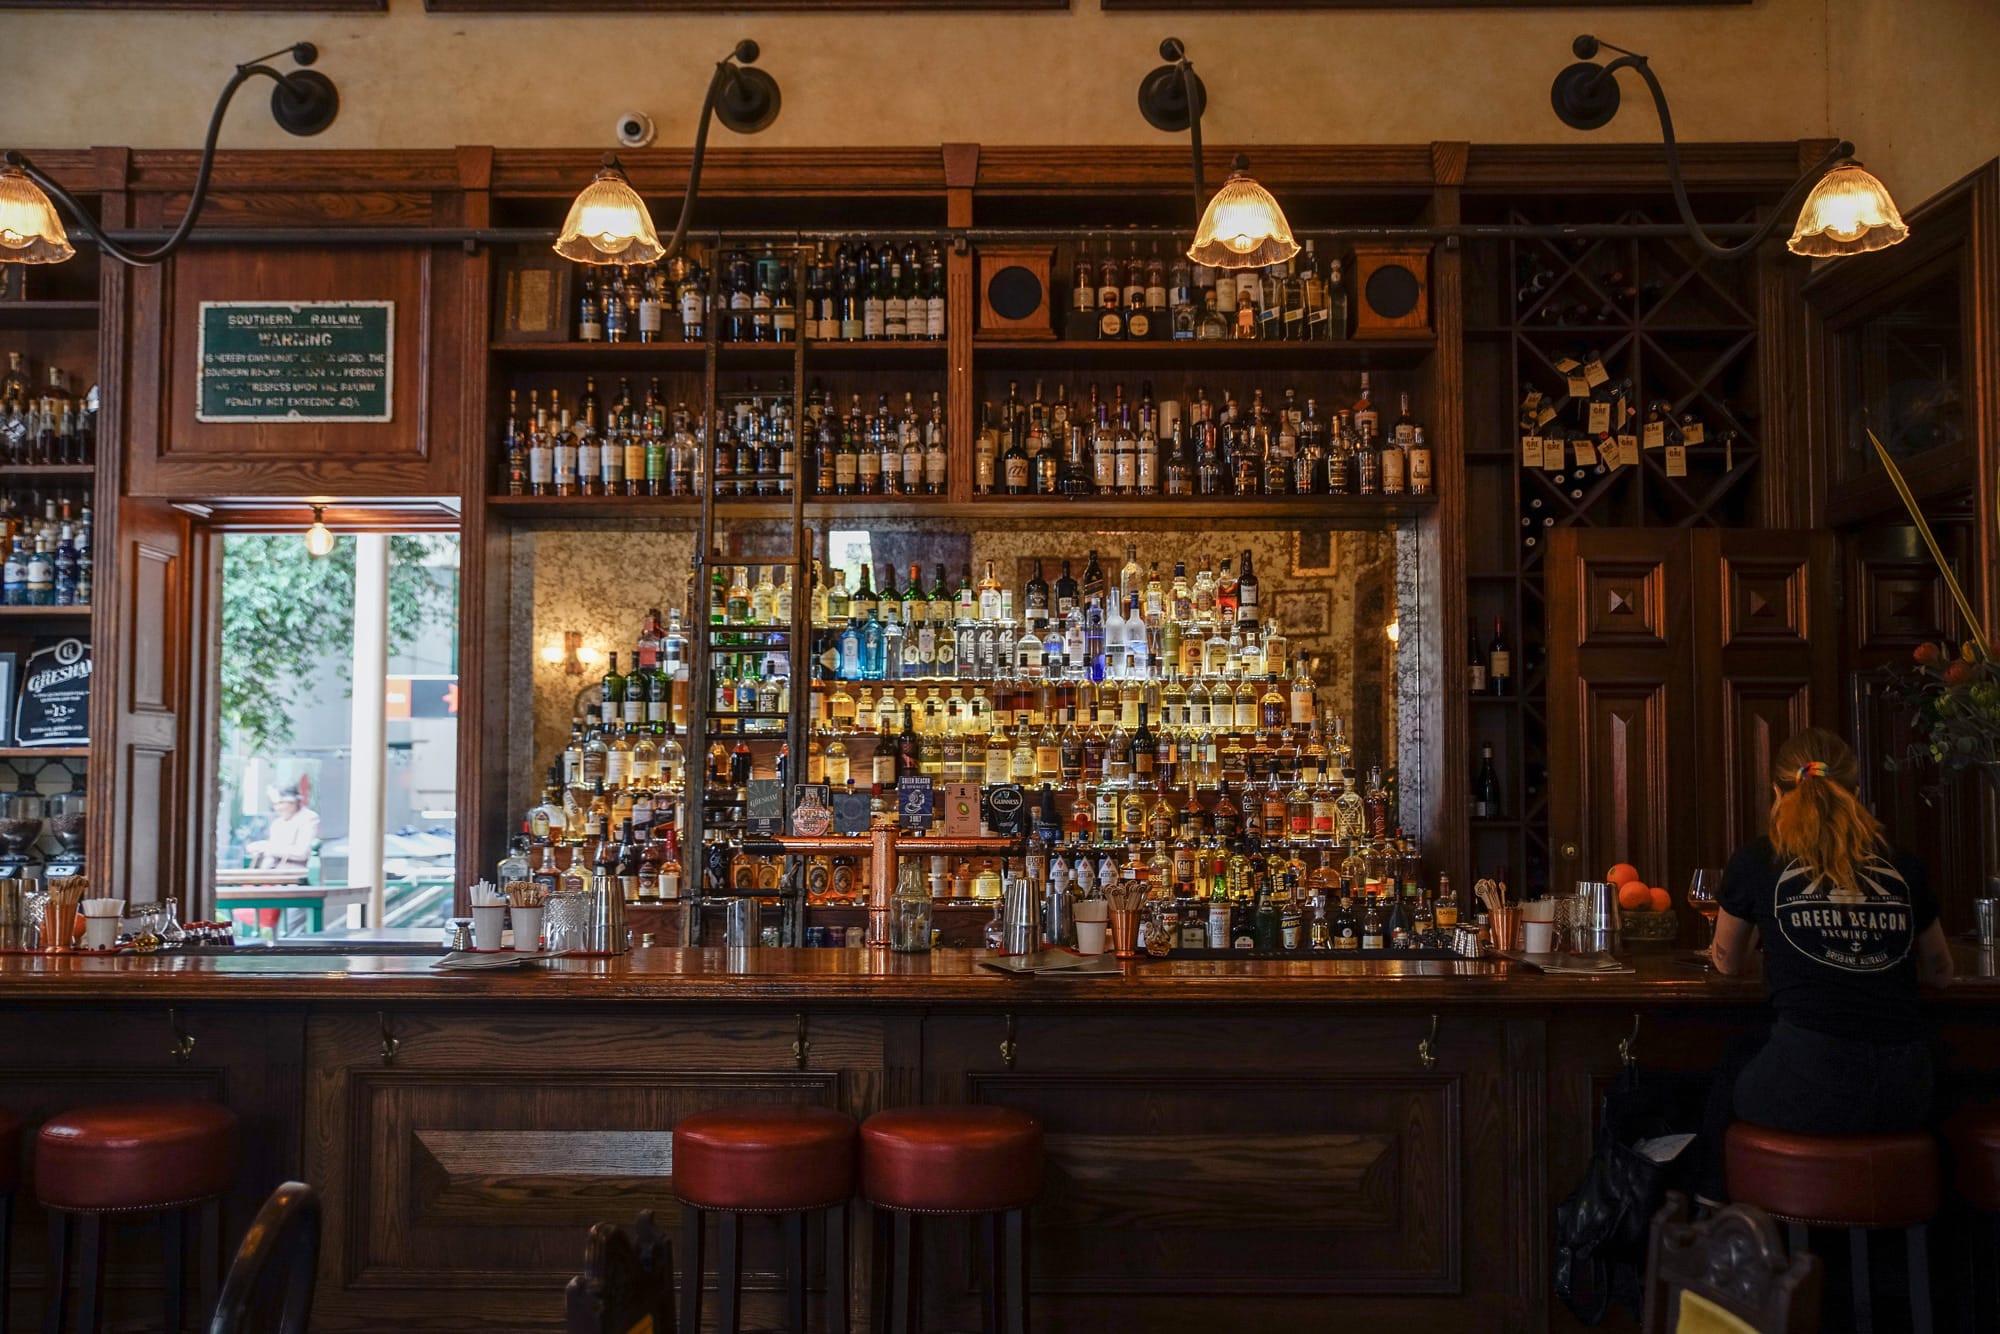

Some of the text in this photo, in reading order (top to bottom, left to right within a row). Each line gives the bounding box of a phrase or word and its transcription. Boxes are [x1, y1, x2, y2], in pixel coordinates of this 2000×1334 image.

[228, 314, 293, 325] SOUTHERN
[258, 333, 332, 346] WARNING
[369, 354, 384, 362] THE
[205, 368, 249, 377] SOUTHERN
[344, 368, 384, 377] PERSONS
[225, 397, 262, 406] PENALTY
[1791, 909, 1907, 931] GREEN BEACON
[1821, 929, 1868, 940] BREWING
